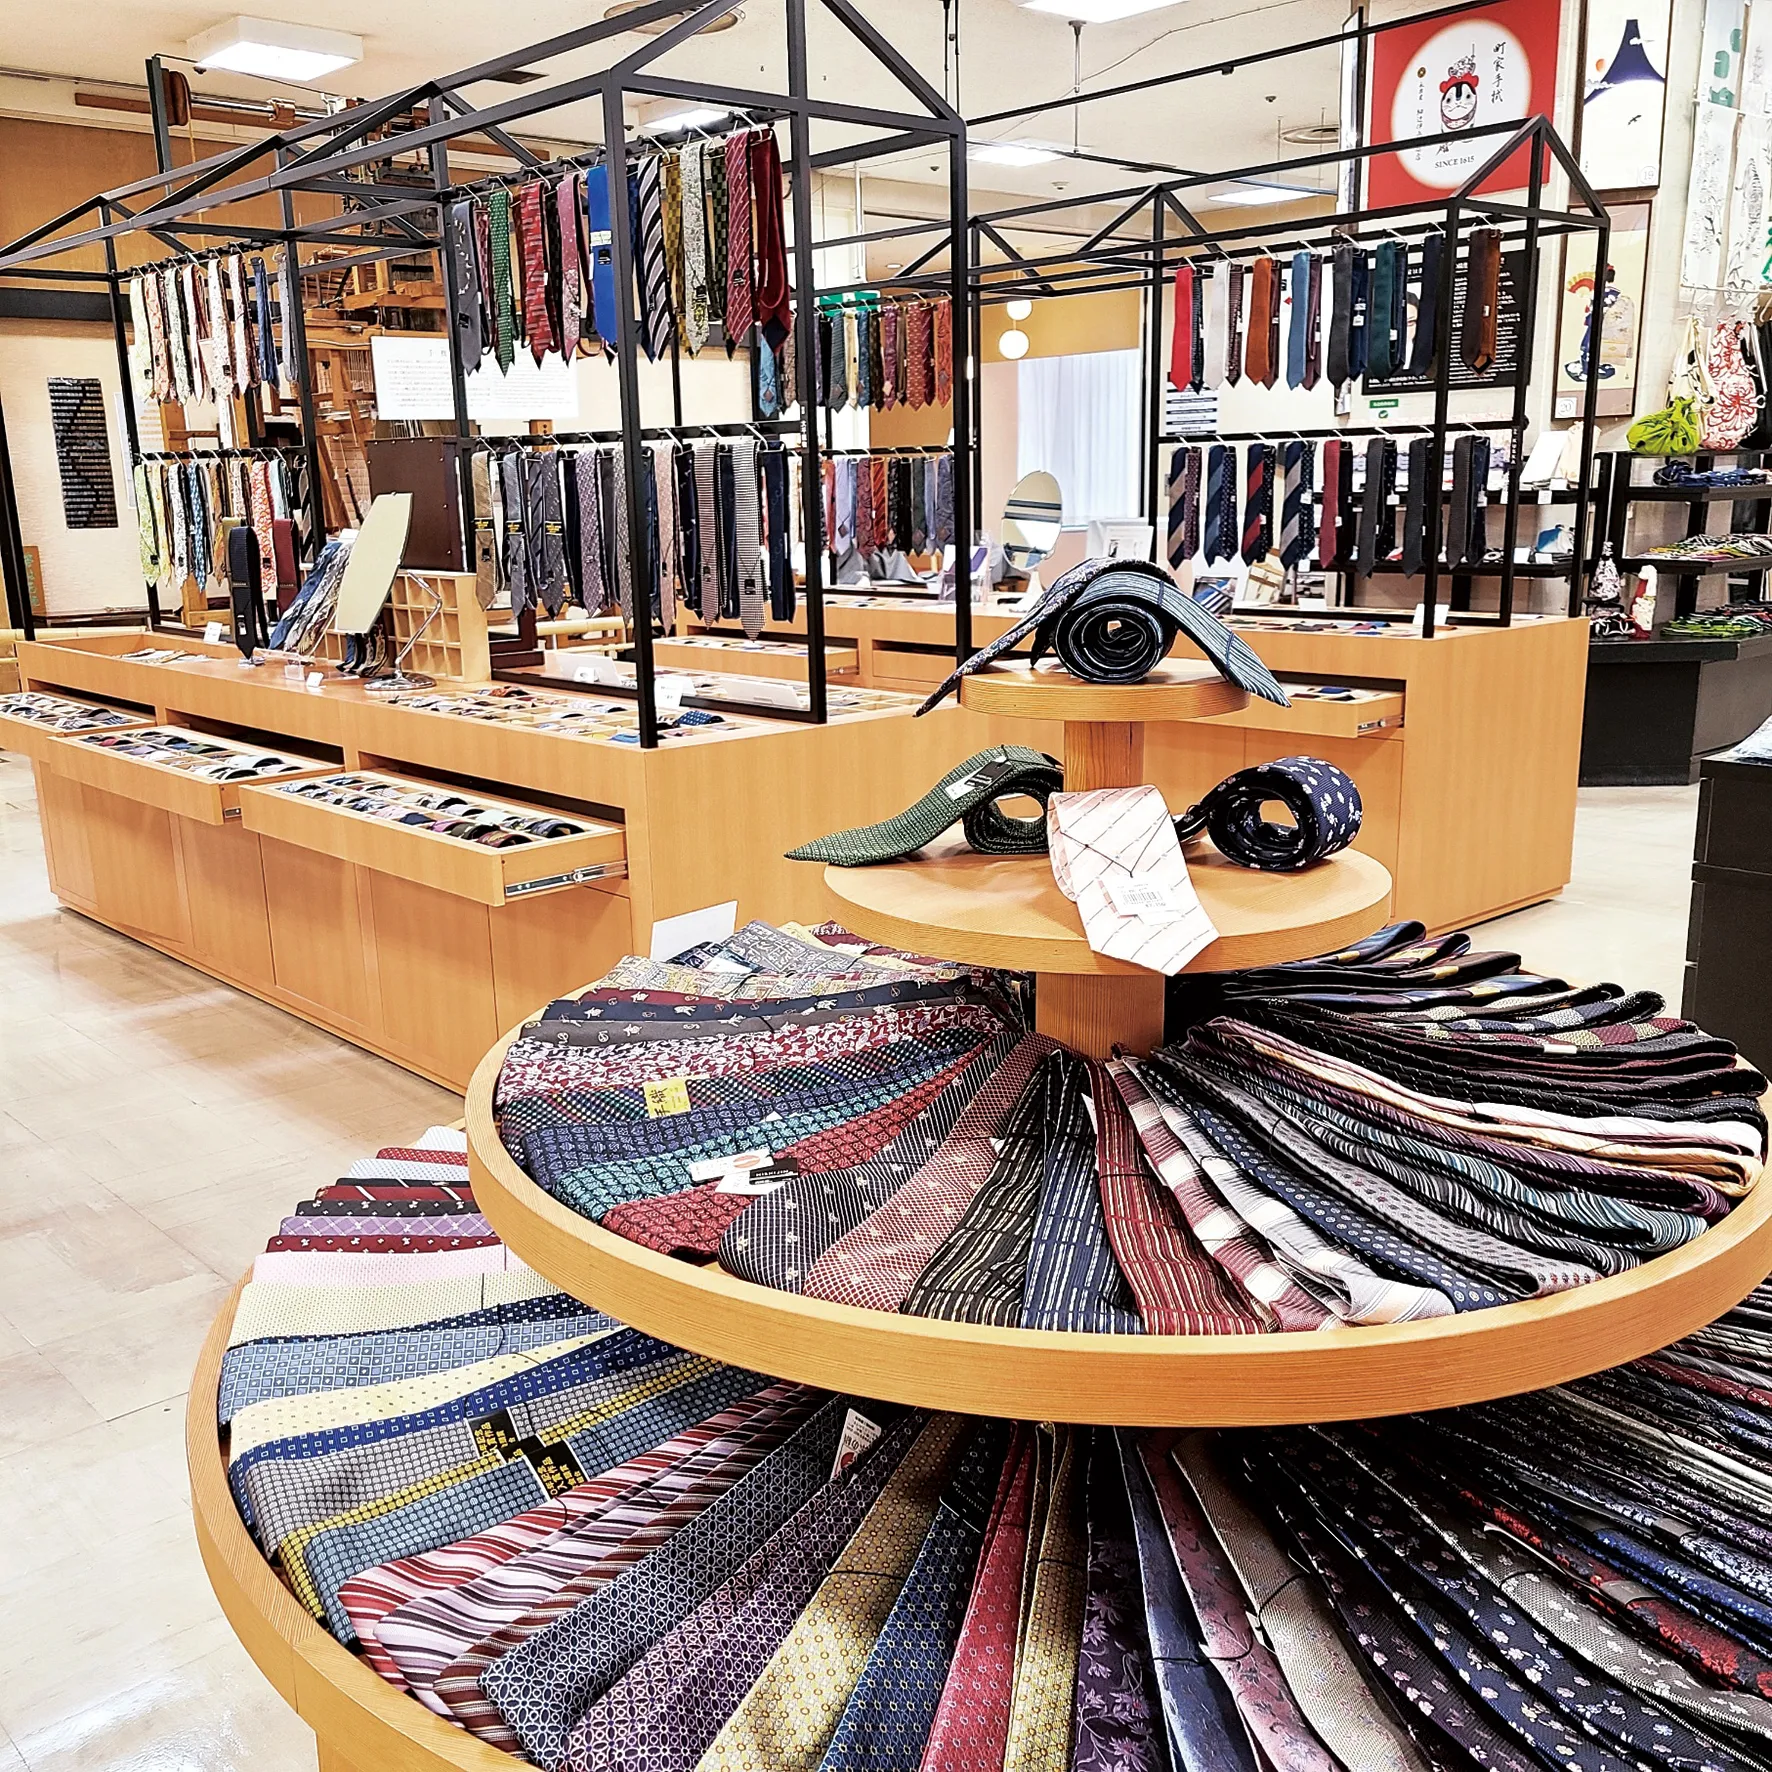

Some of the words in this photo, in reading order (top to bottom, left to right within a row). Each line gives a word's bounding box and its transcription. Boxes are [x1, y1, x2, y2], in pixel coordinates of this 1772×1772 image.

[1435, 158, 1459, 169] SINCE
[1643, 170, 1655, 181] 19
[542, 1456, 568, 1490] 入賞作品
